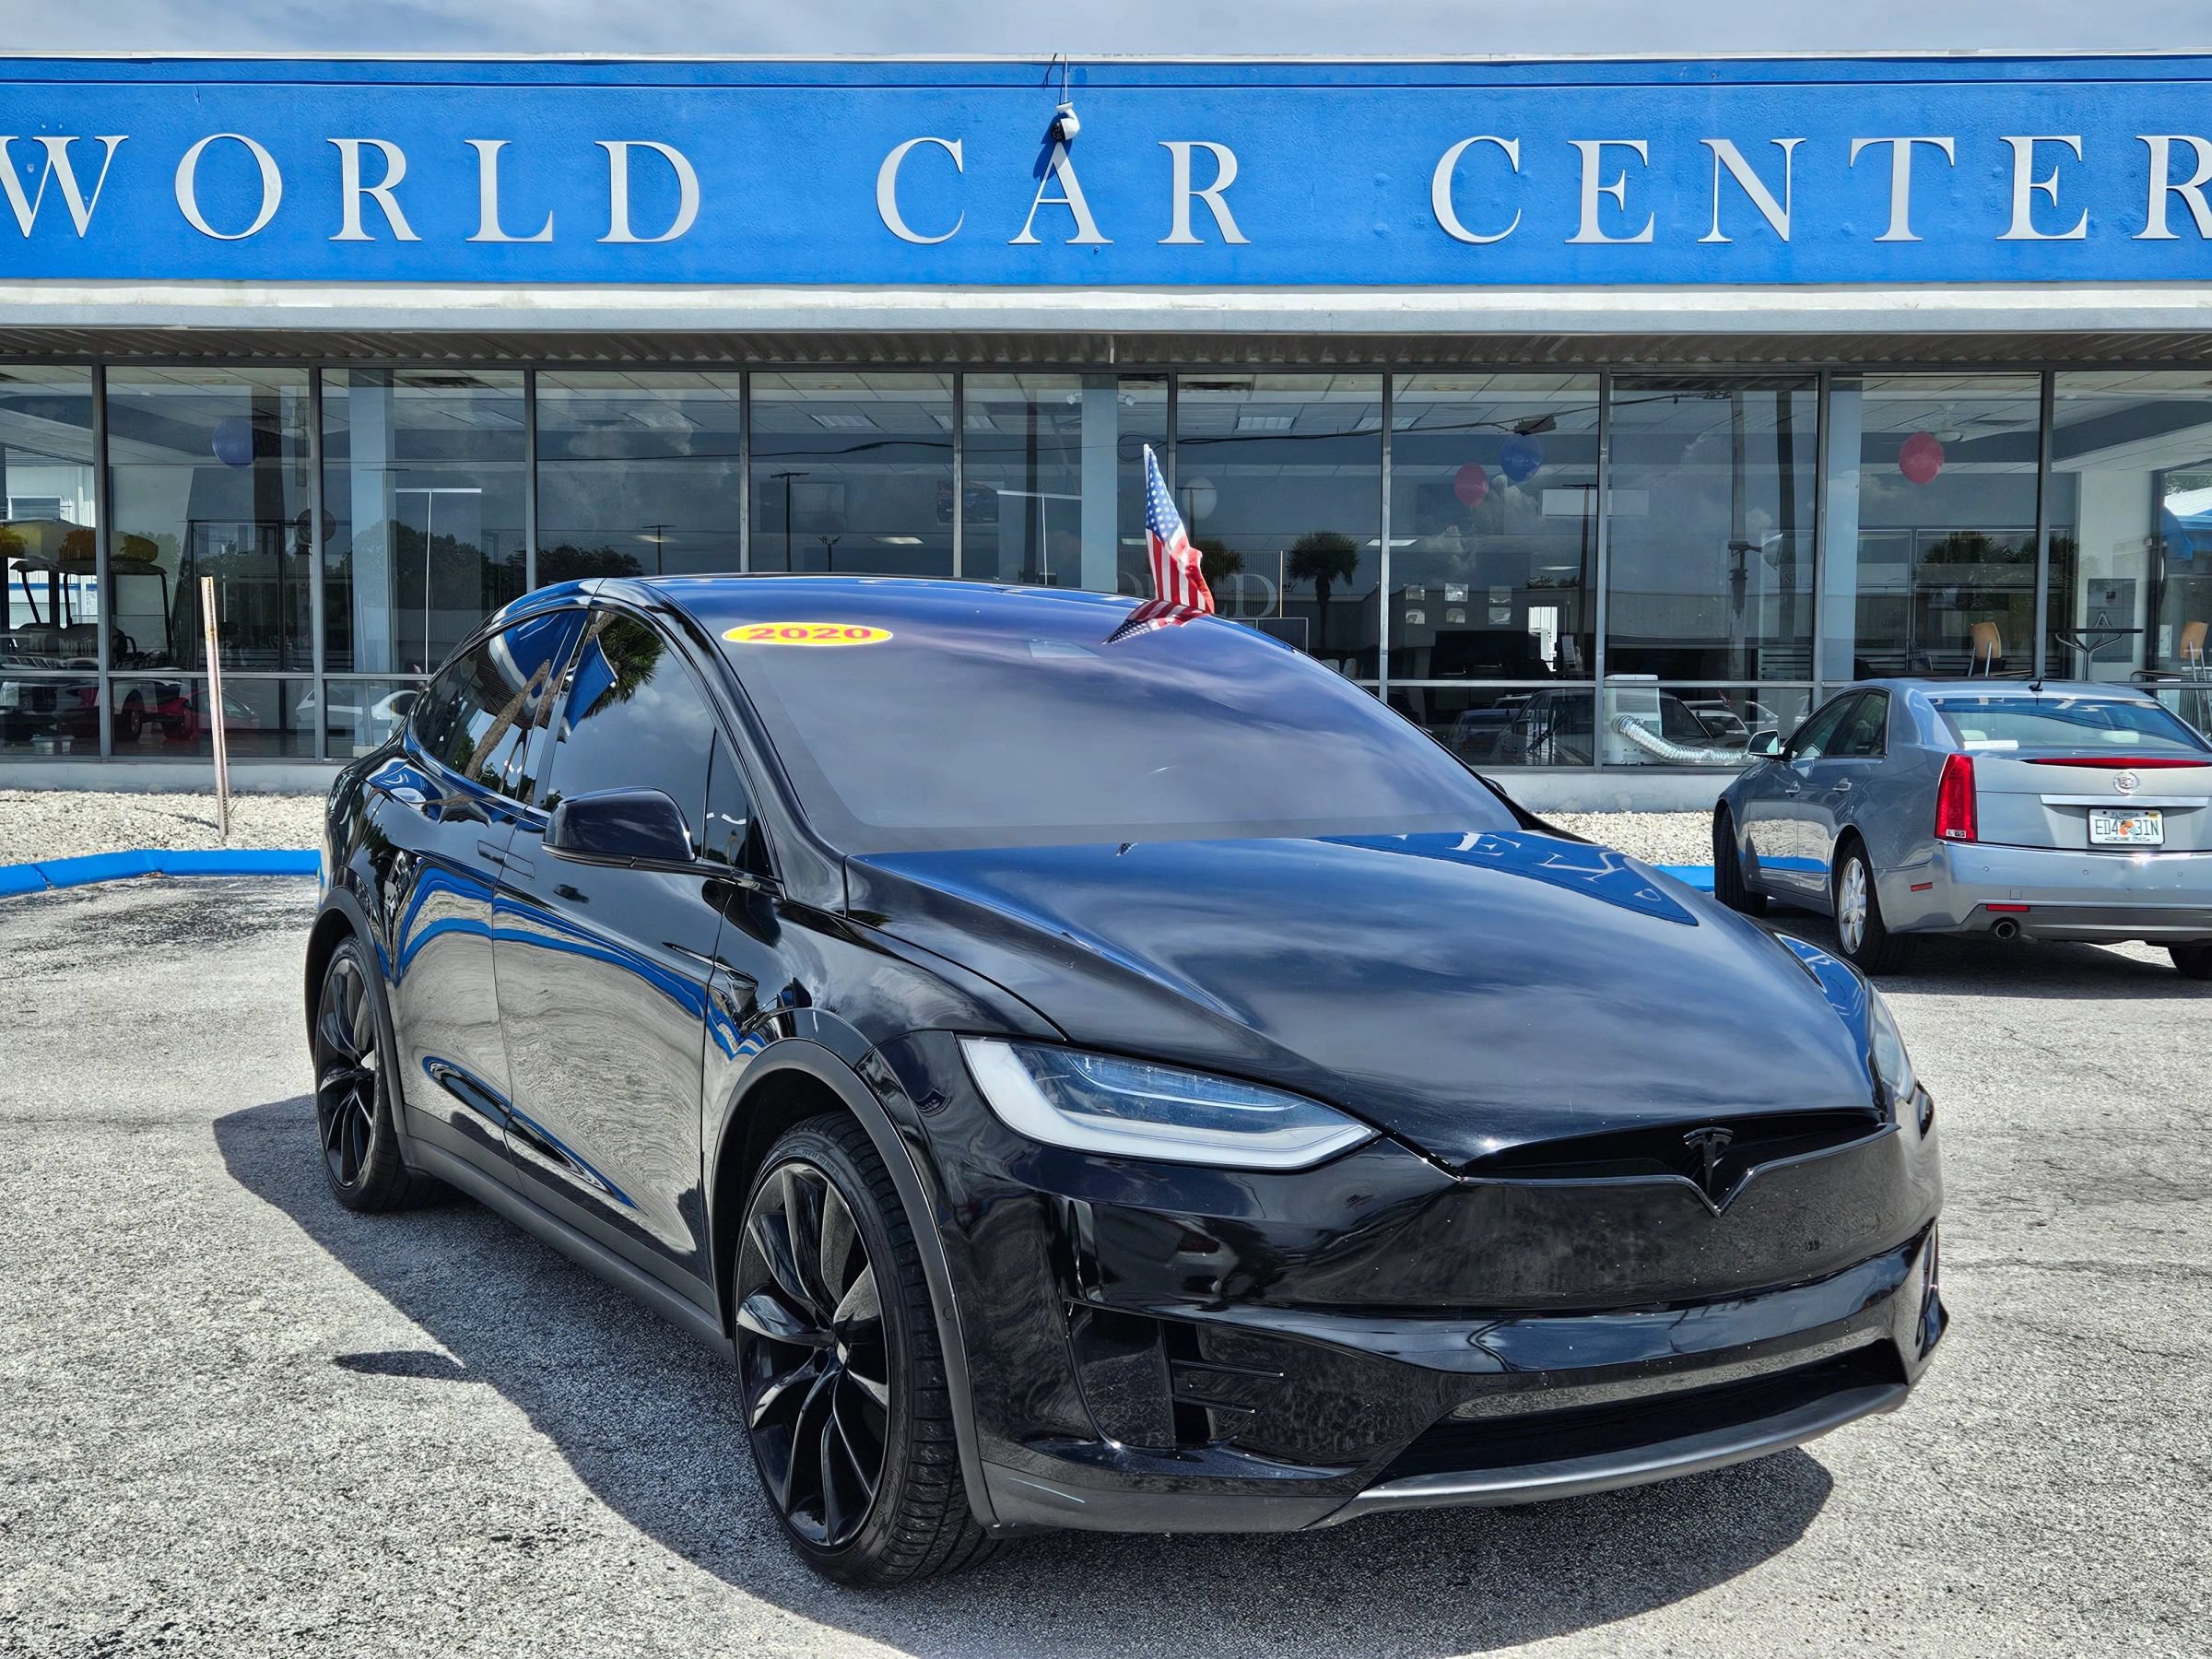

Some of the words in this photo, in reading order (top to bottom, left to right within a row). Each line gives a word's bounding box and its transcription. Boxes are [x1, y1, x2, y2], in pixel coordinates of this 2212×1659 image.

[0, 133, 700, 243] WORLD
[875, 136, 1251, 245] CAR
[1430, 135, 2212, 245] CENTER
[747, 627, 872, 641] 2020
